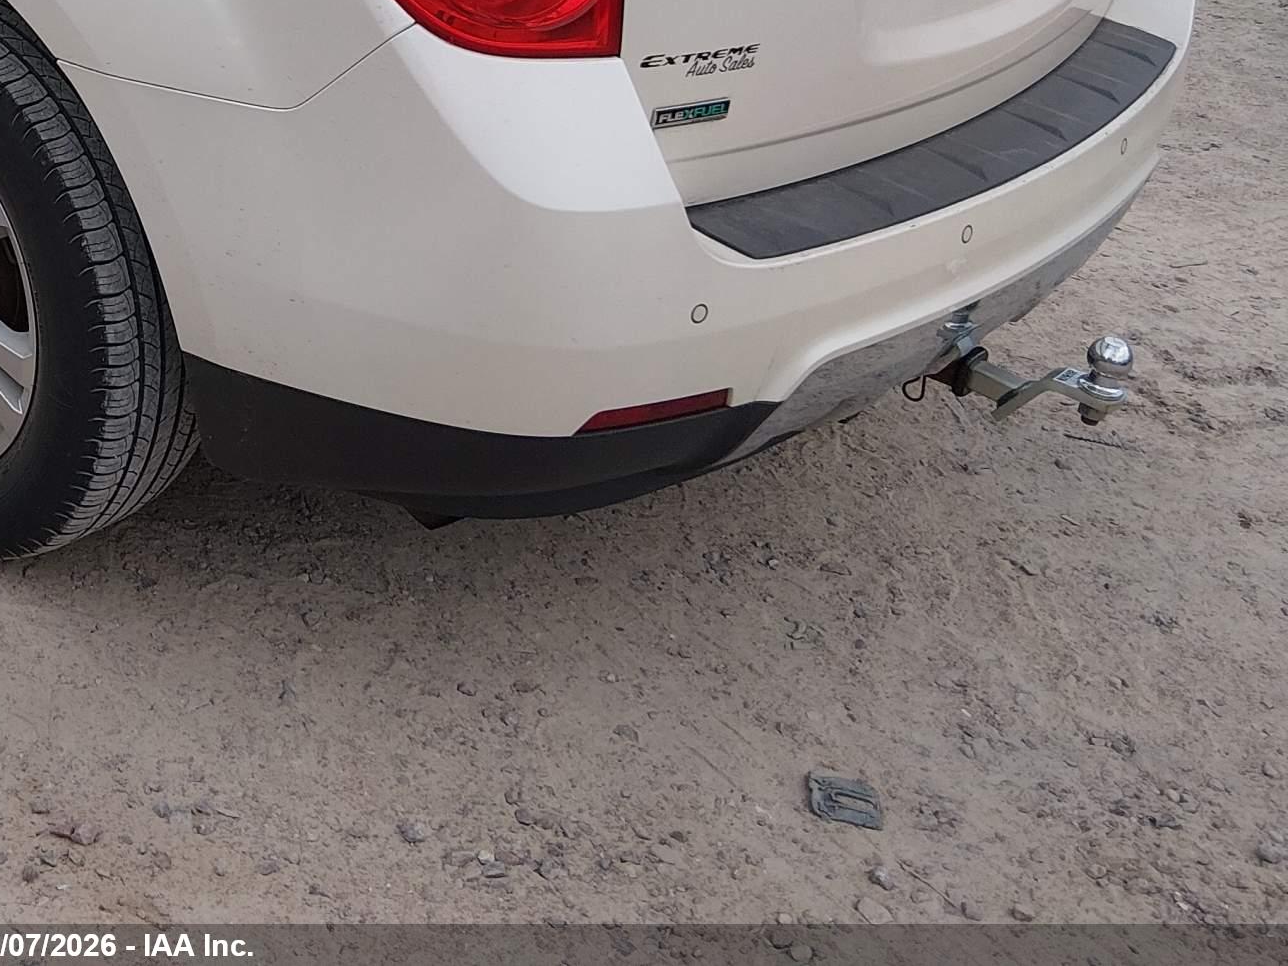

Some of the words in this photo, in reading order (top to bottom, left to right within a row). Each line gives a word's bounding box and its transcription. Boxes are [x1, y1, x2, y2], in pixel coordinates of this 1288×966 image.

[640, 43, 761, 68] EXTREME
[685, 60, 717, 78] Auto
[718, 54, 755, 73] Sales
